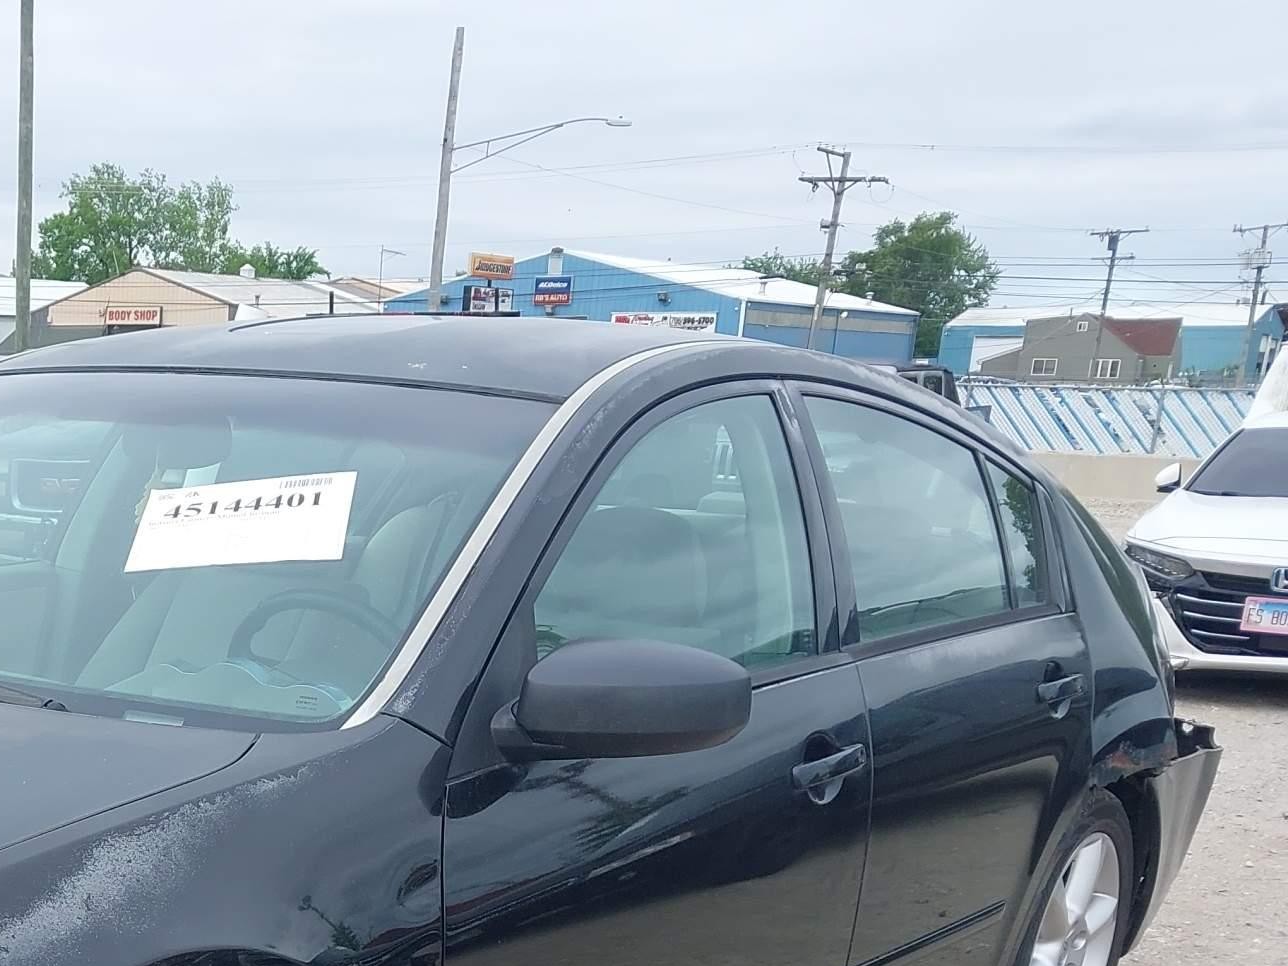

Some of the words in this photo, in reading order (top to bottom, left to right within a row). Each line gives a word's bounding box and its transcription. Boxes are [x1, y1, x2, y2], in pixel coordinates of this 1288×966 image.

[108, 310, 132, 321] BODY
[134, 310, 158, 321] SHOP
[163, 491, 322, 520] 45144401
[1246, 607, 1265, 625] FS
[1271, 609, 1288, 626] 80
